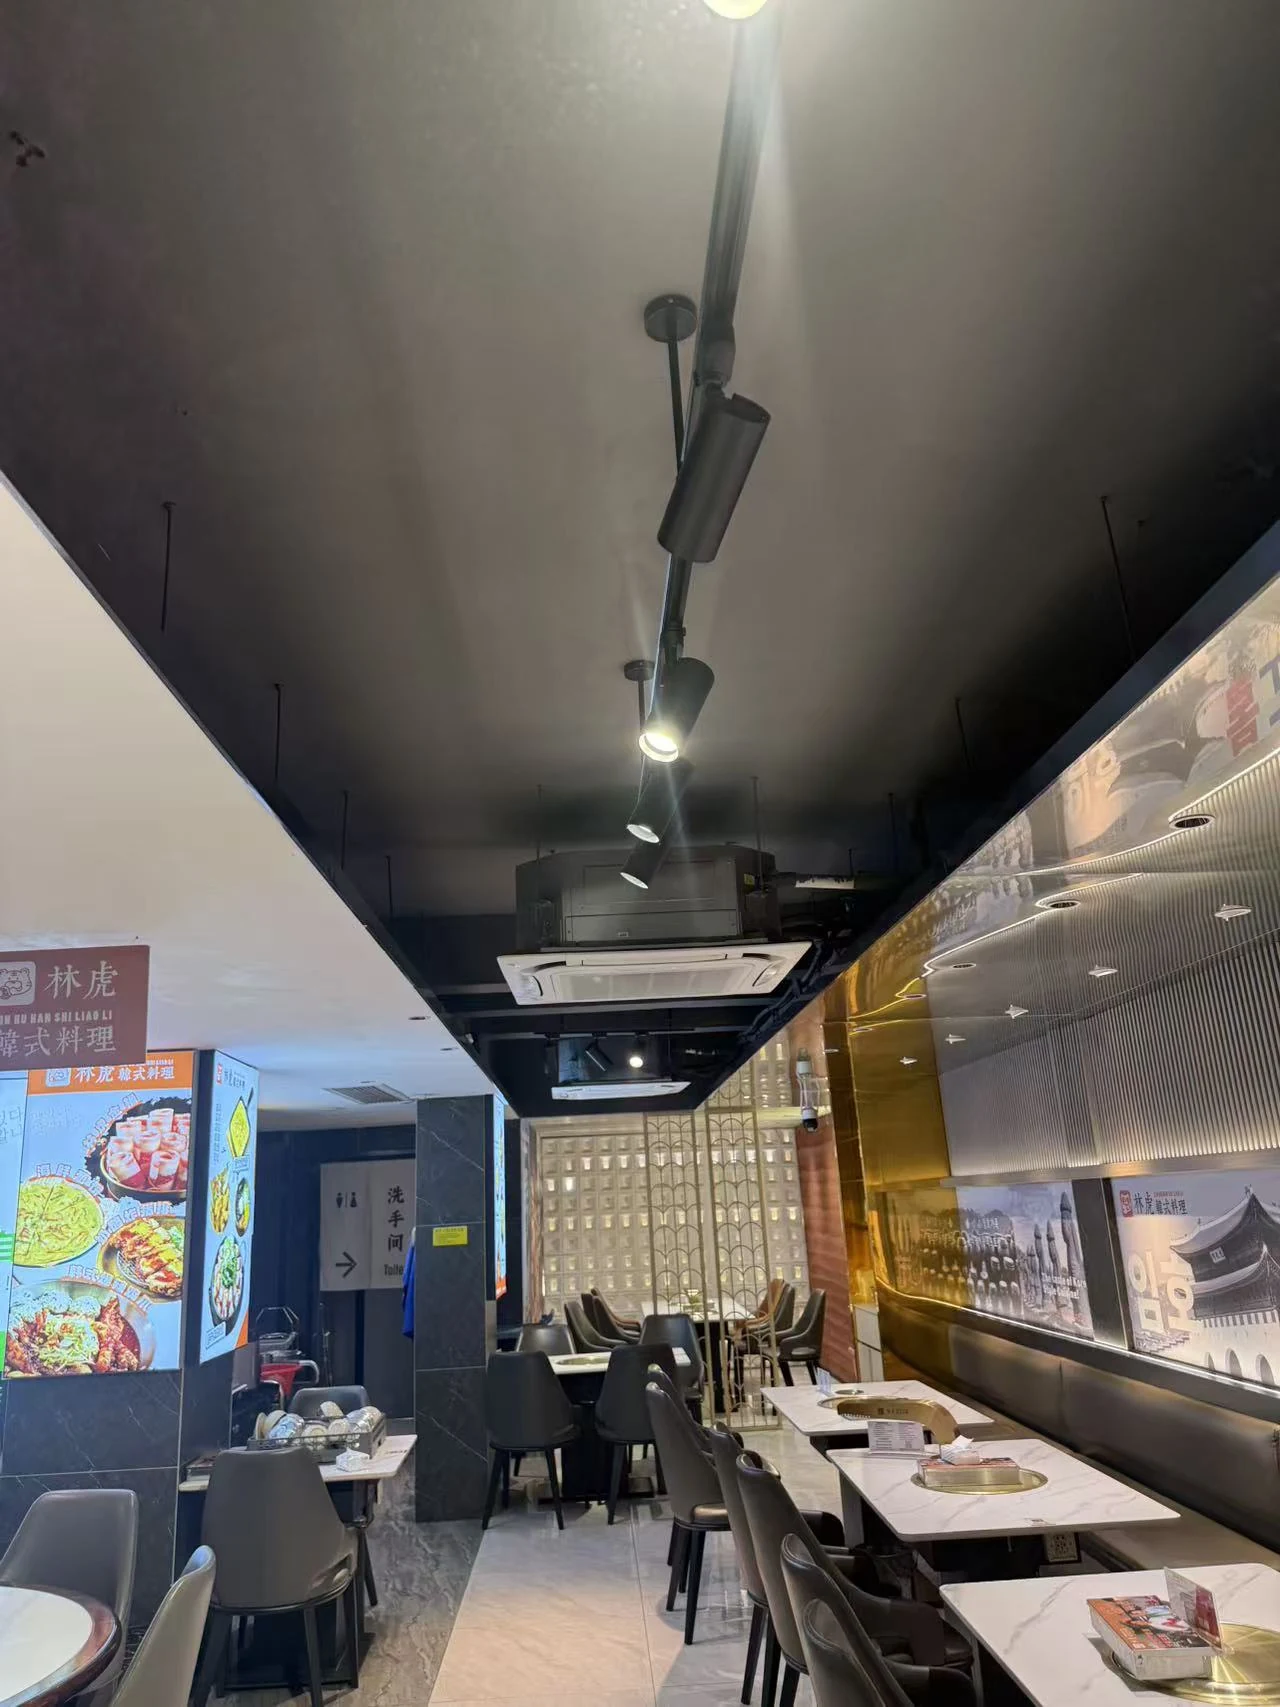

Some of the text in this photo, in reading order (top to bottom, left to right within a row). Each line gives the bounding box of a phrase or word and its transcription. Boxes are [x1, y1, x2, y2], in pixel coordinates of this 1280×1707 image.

[45, 960, 119, 999] 林虎
[14, 1013, 27, 1024] HU
[30, 1012, 51, 1023] HAN
[55, 1010, 71, 1022] SHI
[75, 1009, 98, 1021] LIAO
[102, 1009, 112, 1020] LI
[1134, 1191, 1154, 1215] 林虎
[388, 1185, 405, 1251] 洗手间
[384, 1263, 404, 1276] Toile
